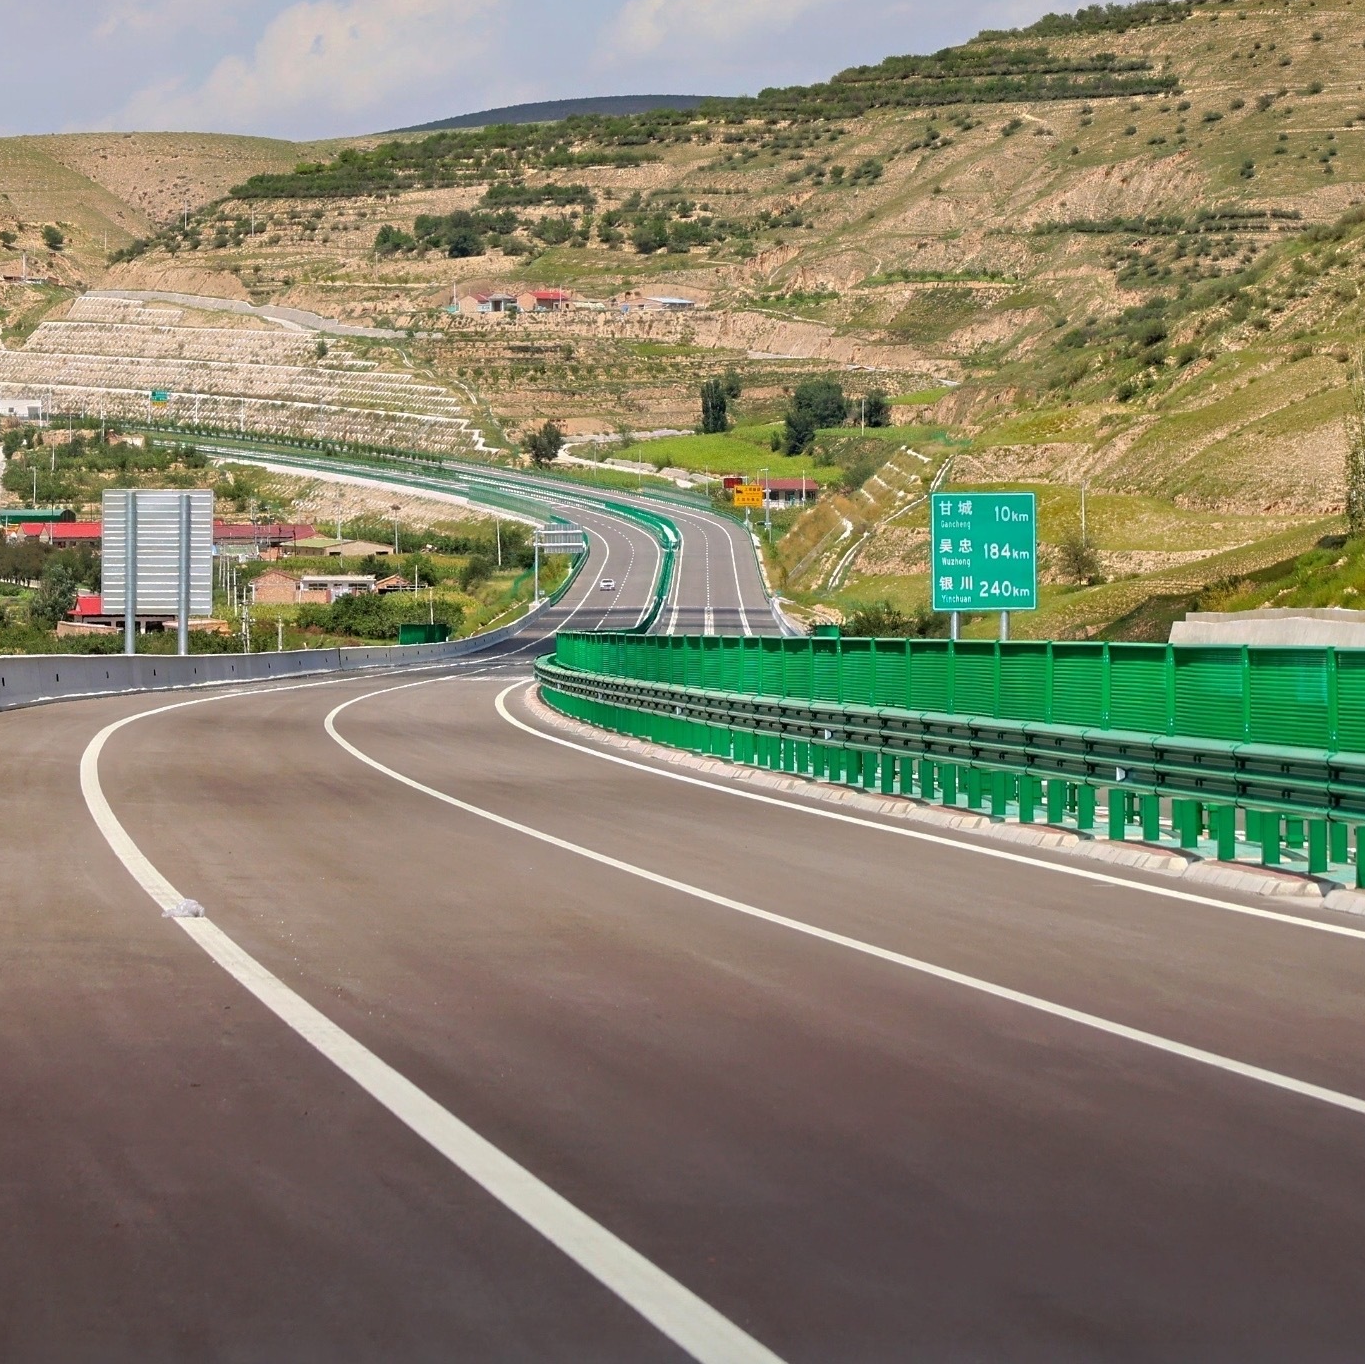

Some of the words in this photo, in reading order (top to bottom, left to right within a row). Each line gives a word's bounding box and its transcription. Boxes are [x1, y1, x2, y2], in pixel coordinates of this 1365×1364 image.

[939, 500, 973, 516] 甘城
[994, 506, 1029, 522] 10km
[940, 520, 971, 530] Gancheng
[939, 538, 973, 554] 吴忠
[983, 543, 1030, 560] 184km
[941, 557, 971, 567] Wuzhong
[939, 576, 973, 591] 银川
[979, 581, 1030, 597] 240km
[941, 594, 972, 603] Yinchuan
